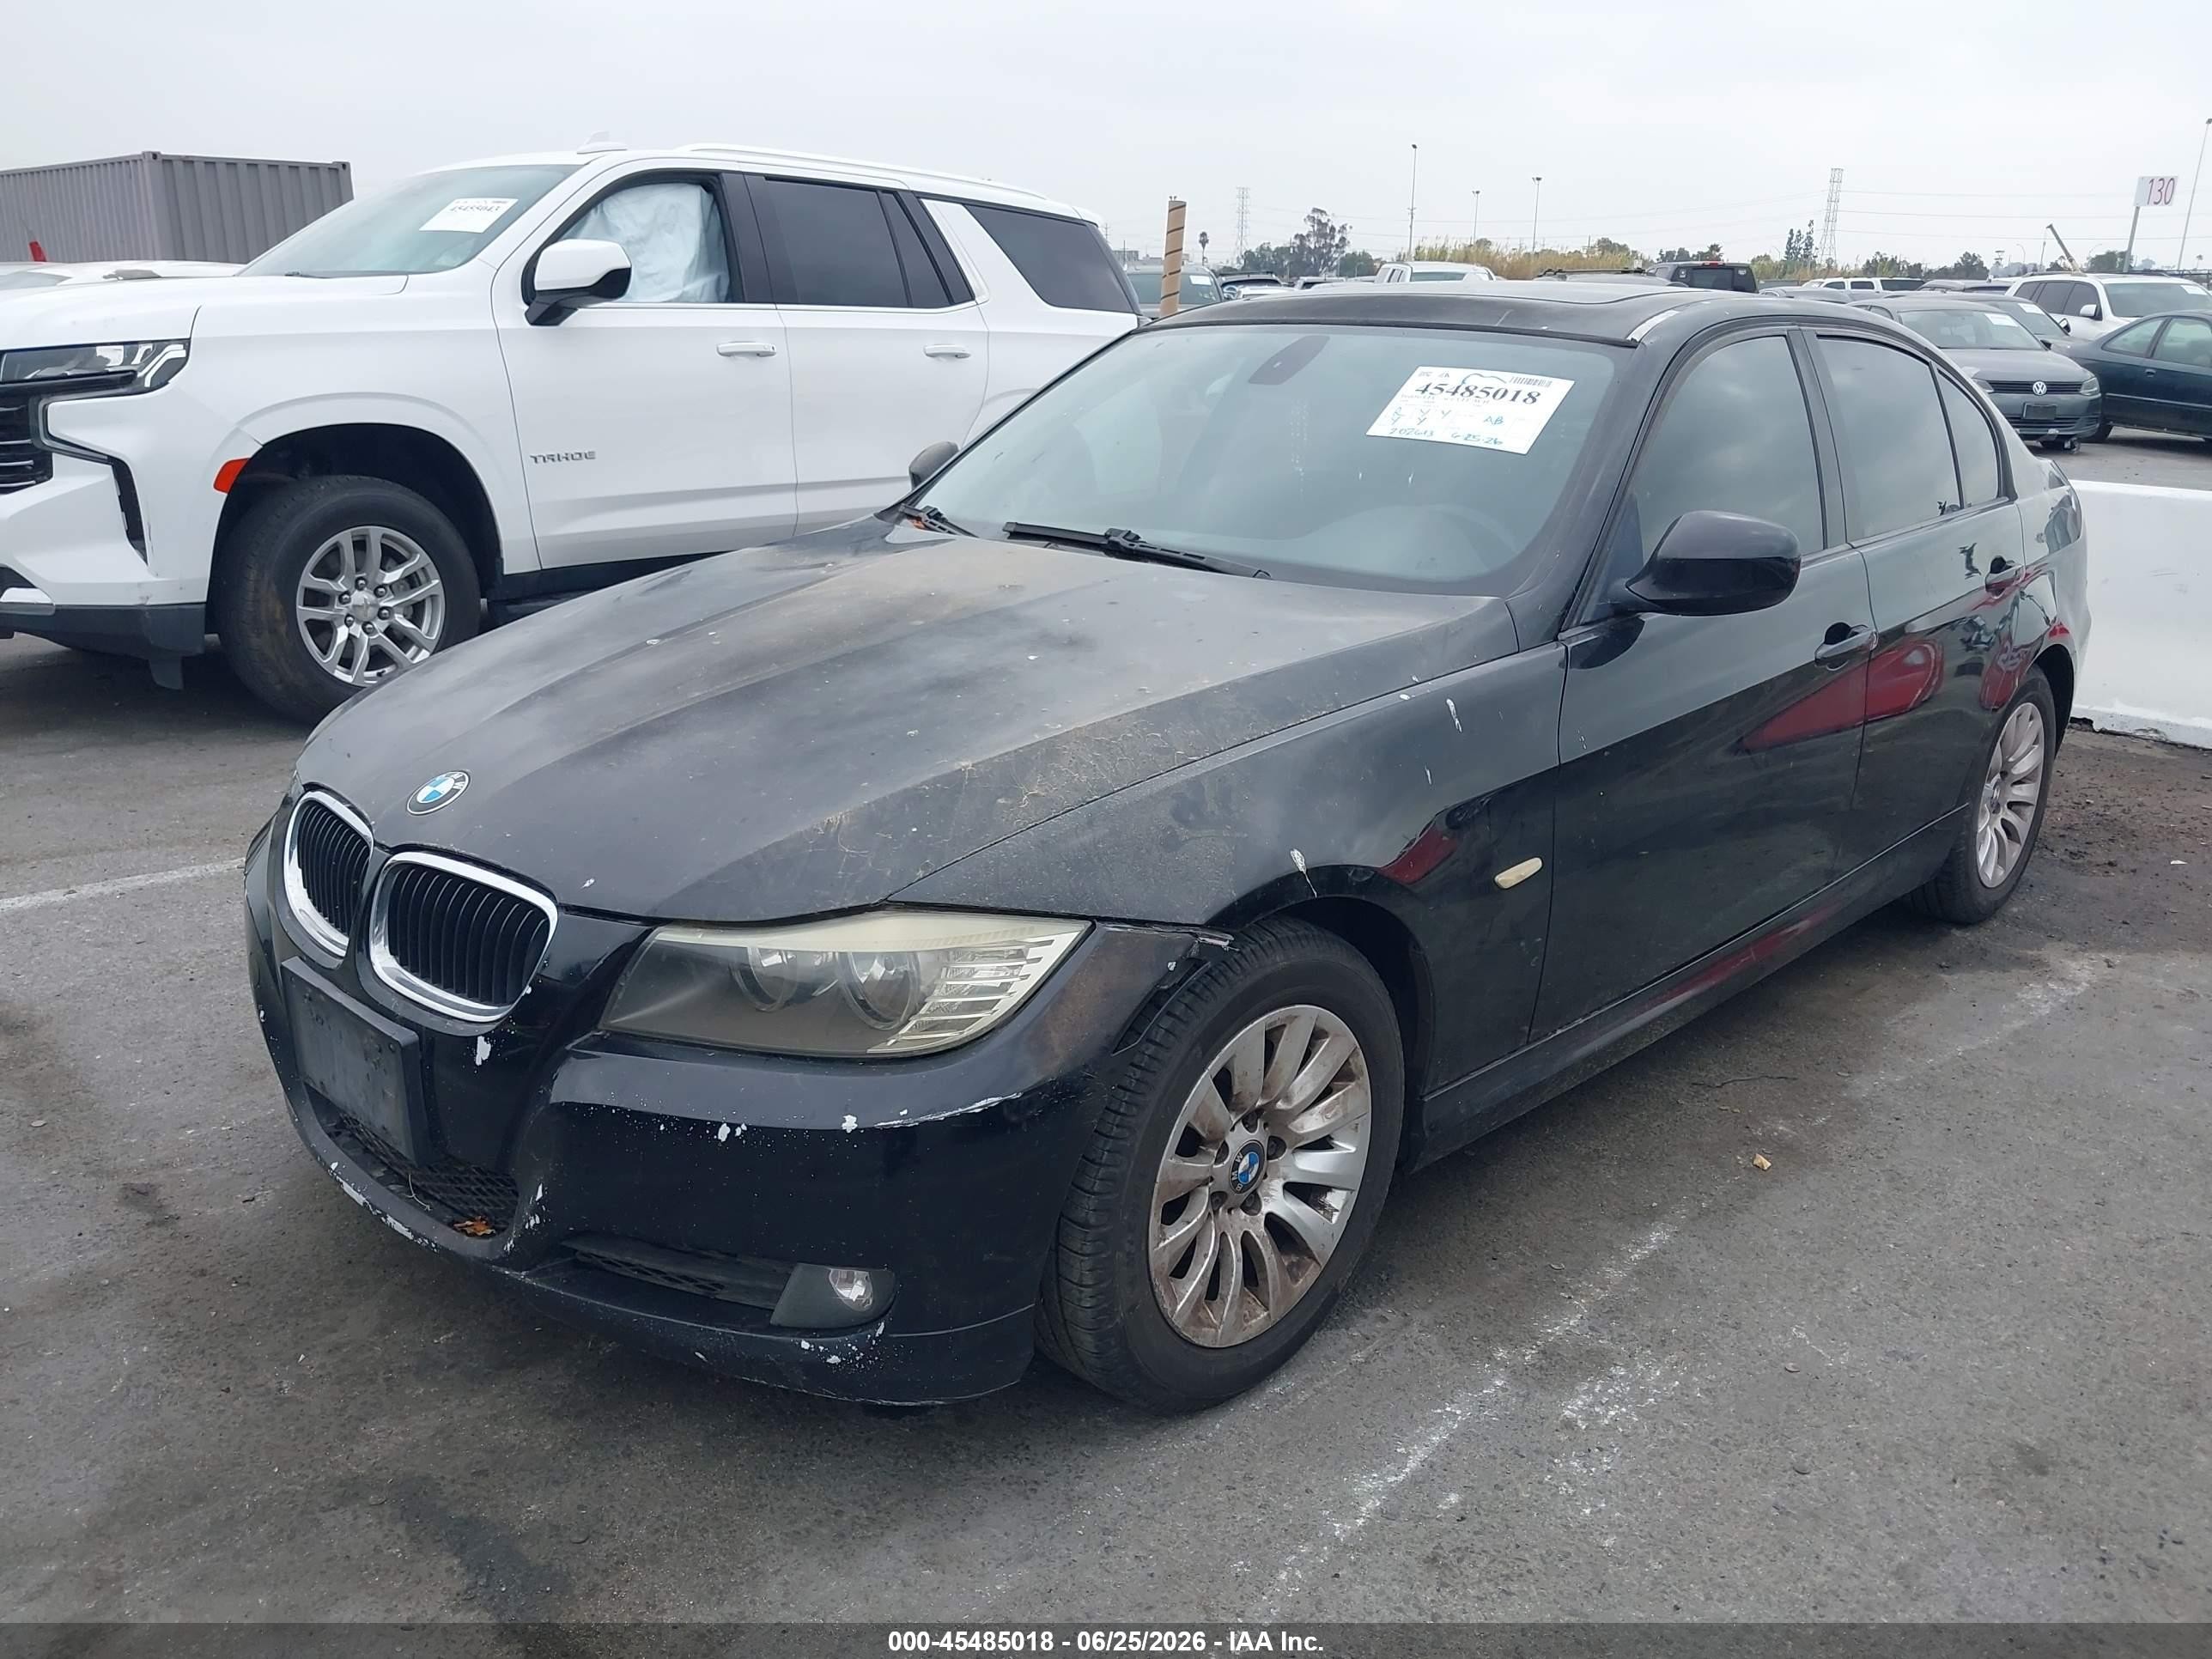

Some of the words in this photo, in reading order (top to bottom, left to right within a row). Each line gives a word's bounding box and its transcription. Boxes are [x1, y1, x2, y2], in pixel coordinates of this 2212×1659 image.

[2147, 177, 2175, 205] 130
[1415, 381, 1542, 405] 45485018
[530, 451, 596, 464] TAHOE
[1231, 1152, 1243, 1191] BMW
